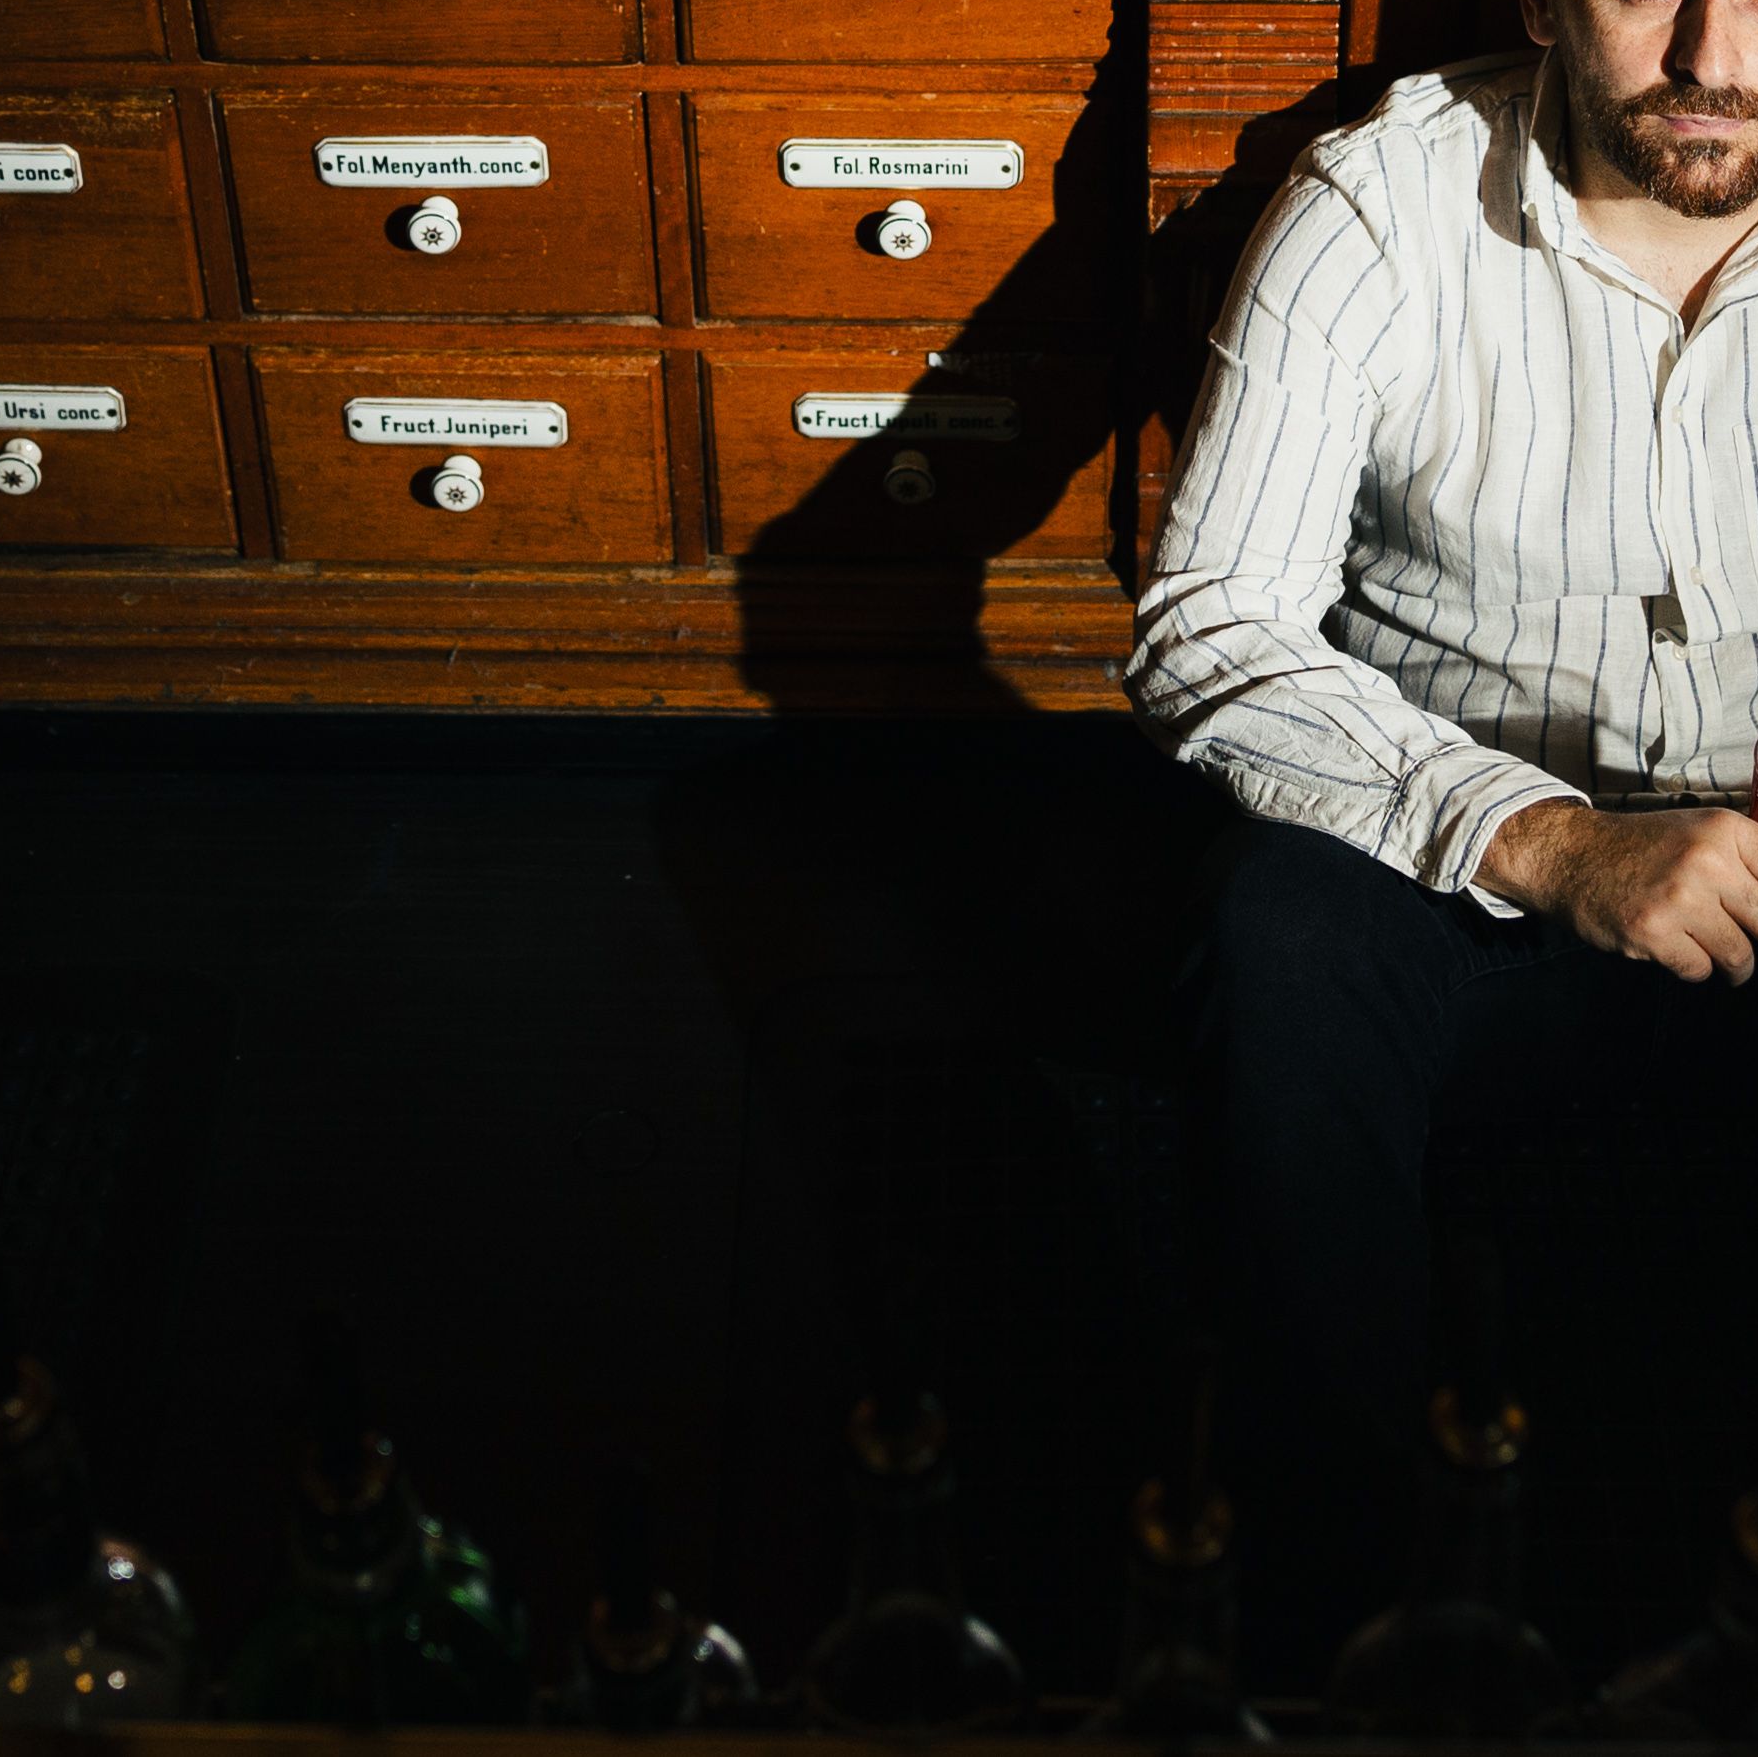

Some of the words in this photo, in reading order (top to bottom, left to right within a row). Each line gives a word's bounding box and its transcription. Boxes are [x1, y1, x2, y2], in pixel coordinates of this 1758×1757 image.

[14, 166, 66, 181] conc.
[833, 156, 864, 176] Fol.
[869, 156, 969, 176] Rosmarini
[4, 401, 46, 419] Ursi
[57, 406, 105, 421] conc.
[948, 411, 1001, 431] conc.
[444, 417, 528, 439] Juniperi
